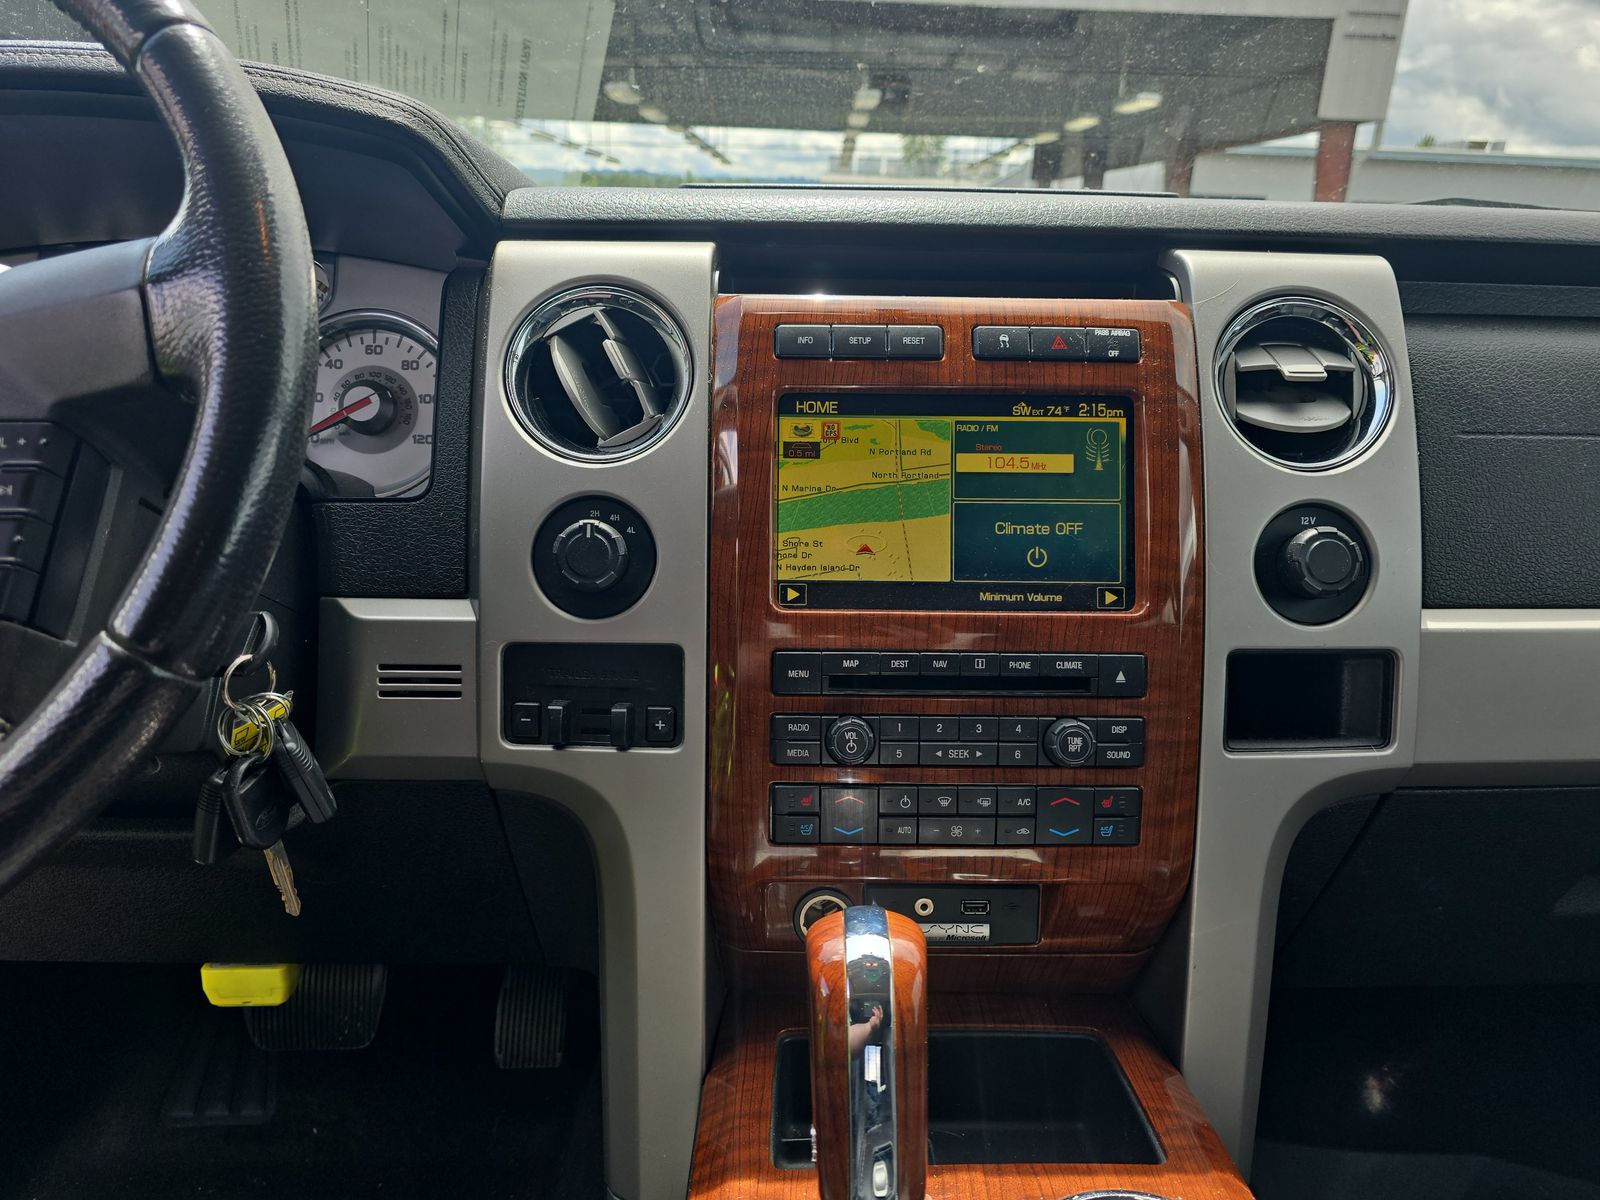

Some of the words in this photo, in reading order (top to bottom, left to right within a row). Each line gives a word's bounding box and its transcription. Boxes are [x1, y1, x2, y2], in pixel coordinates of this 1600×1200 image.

[797, 336, 814, 344] INFO
[848, 336, 872, 345] SETUP
[902, 336, 926, 345] RESET
[364, 344, 383, 355] 60
[1108, 350, 1120, 358] OFF
[324, 359, 344, 369] 40
[401, 360, 420, 371] 80
[796, 401, 839, 414] HOME
[1012, 405, 1032, 416] SW
[1047, 406, 1062, 416] 74
[1078, 403, 1124, 418] 2:15pm
[956, 424, 979, 432] RADIO
[986, 424, 999, 432] FM
[841, 436, 859, 444] Blvd
[975, 443, 1003, 451] Stereo
[869, 448, 876, 456] N
[879, 448, 917, 456] Portland
[920, 448, 932, 456] Rd
[987, 456, 1030, 470] 104.5
[1031, 462, 1047, 471] MHz
[871, 471, 898, 480] North
[901, 472, 940, 480] Portland
[782, 484, 788, 492] N
[791, 484, 822, 492] Marine
[590, 510, 600, 518] 2H
[609, 513, 620, 521] 4H
[626, 526, 636, 534] 4L
[994, 521, 1050, 535] Climate
[1055, 522, 1084, 535] OFF
[782, 540, 810, 548] Shore
[812, 540, 824, 548] St
[801, 551, 813, 559] Dr
[785, 563, 817, 572] Hayden
[820, 563, 846, 572] Island
[848, 564, 860, 572] Dr
[979, 591, 1024, 602] Minimum
[1027, 592, 1063, 602] Volume
[842, 659, 860, 668] MAP
[890, 659, 909, 668] DEST
[932, 659, 948, 668] NAV
[1008, 661, 1032, 670] PHONE
[1055, 661, 1083, 670] CLIMATE
[788, 669, 810, 678] MENU
[788, 723, 810, 732] RADIO
[936, 723, 943, 733] 2
[975, 723, 983, 733] 3
[1015, 723, 1022, 733] 4
[1111, 725, 1128, 733] DISP
[844, 731, 859, 740] VOL
[1066, 736, 1083, 745] TUNE
[787, 749, 810, 757] MEDIA
[1068, 744, 1082, 753] RPT
[896, 749, 903, 758] 5
[948, 749, 970, 759] SEEK
[1014, 749, 1021, 759] 6
[1106, 750, 1131, 759] SOUND
[1017, 798, 1032, 807] A/C
[897, 826, 912, 834] AUTO
